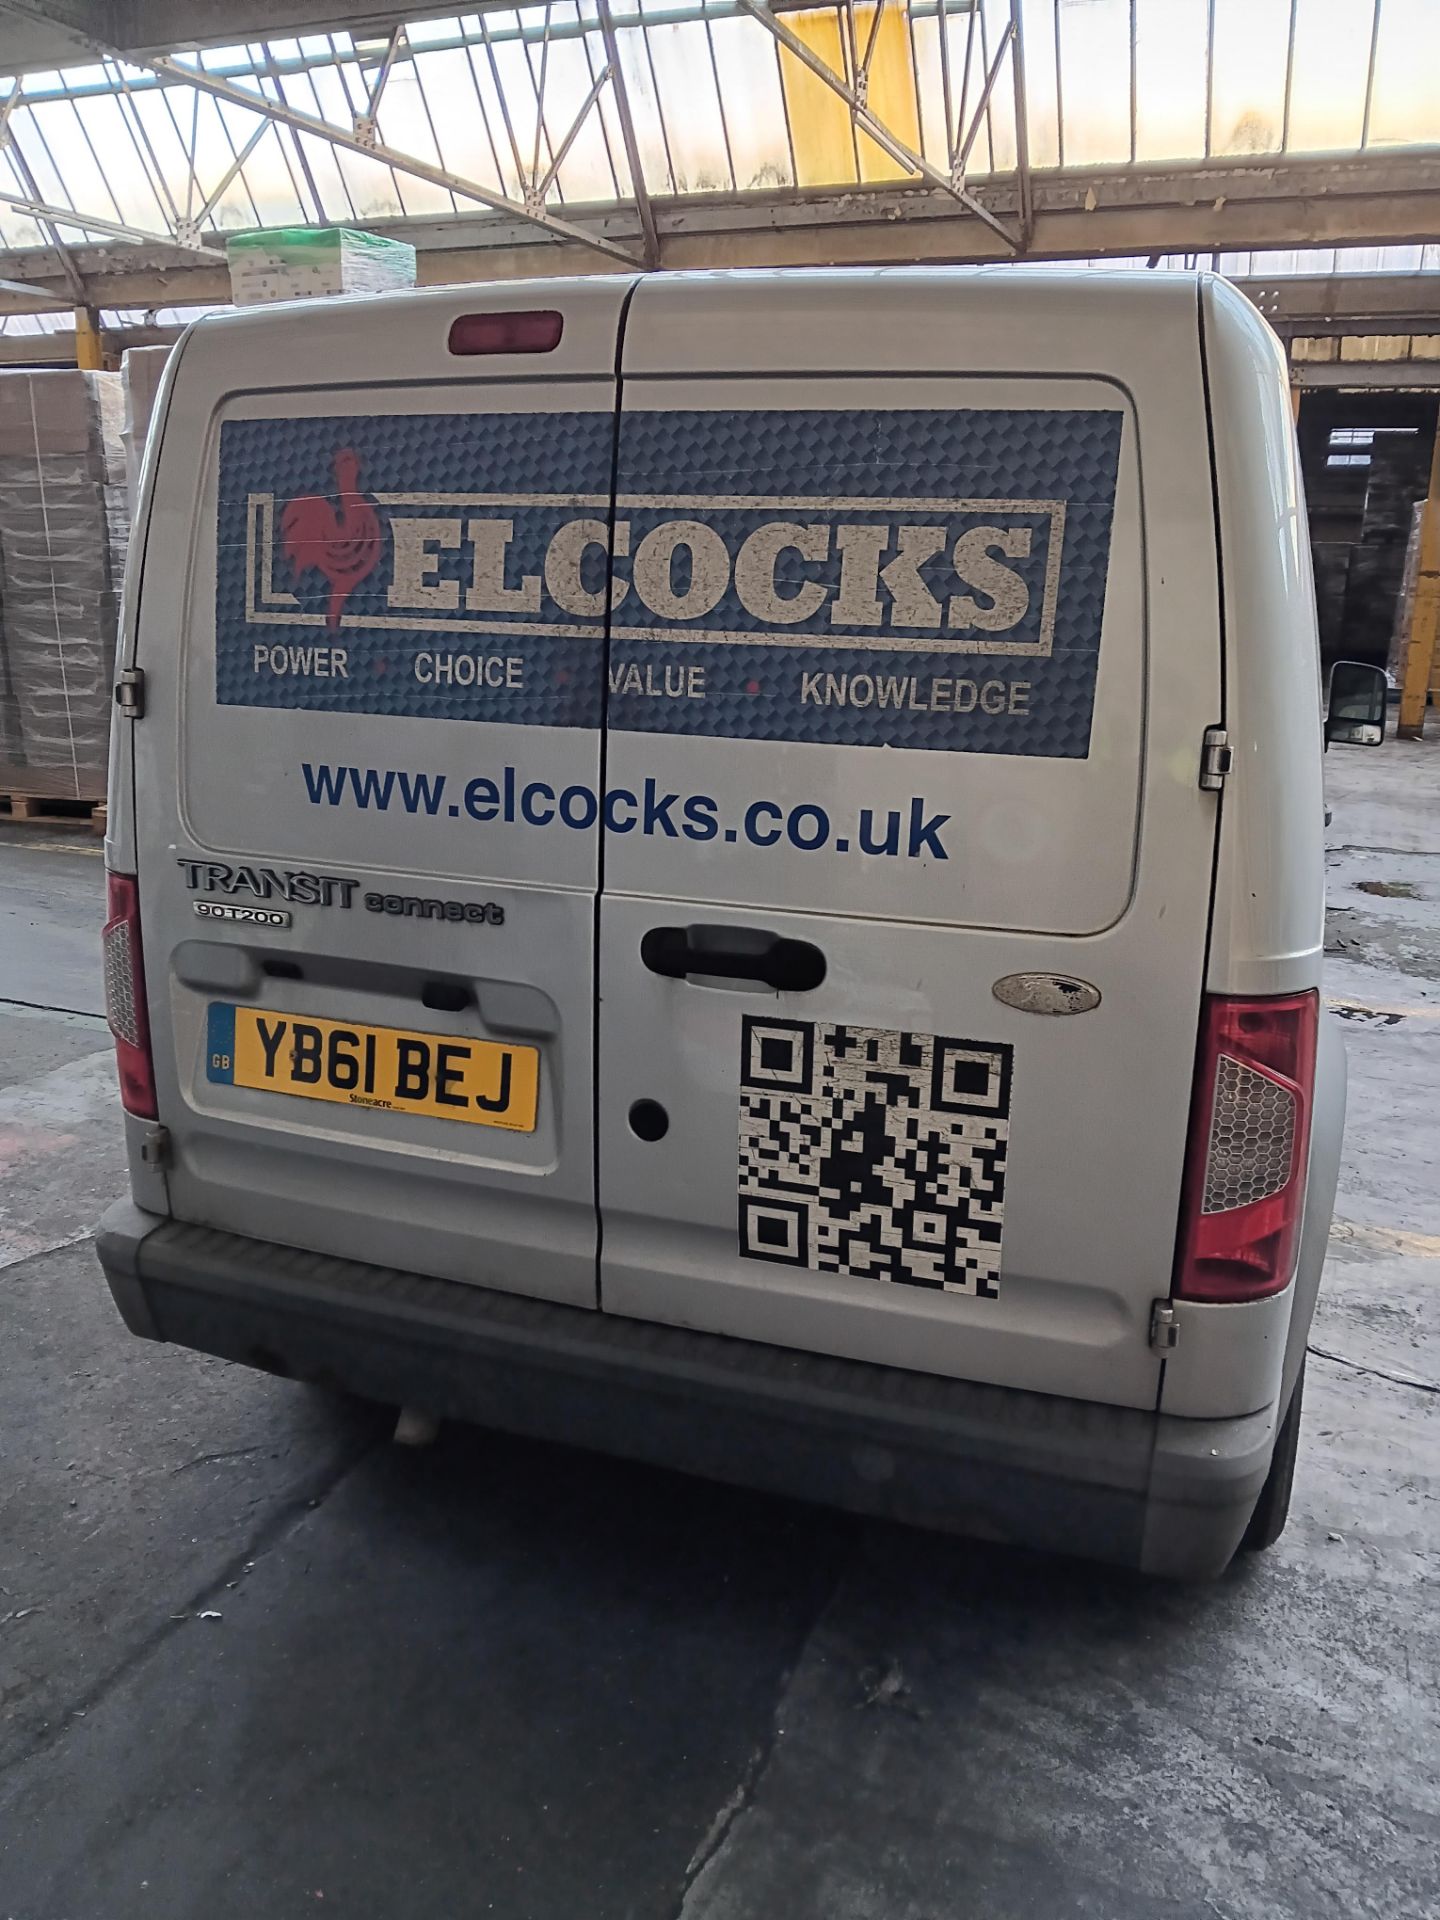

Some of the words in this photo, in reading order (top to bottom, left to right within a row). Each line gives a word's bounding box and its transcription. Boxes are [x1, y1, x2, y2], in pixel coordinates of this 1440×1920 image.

[387, 517, 1033, 632] ELCOCKS
[253, 644, 349, 679] POWER
[414, 652, 525, 689] CHOICE
[608, 662, 706, 699] VALUE
[800, 672, 1032, 716] KNOWLEDGE
[302, 762, 952, 860] www.elcocks.co.uk
[177, 858, 360, 909] TRANSIT
[363, 892, 505, 926] connect
[196, 902, 284, 926] 90T200
[212, 1053, 230, 1070] GB
[256, 1017, 376, 1093] YB61
[394, 1038, 512, 1113] BEJ
[349, 1093, 393, 1109] Stoneacre
